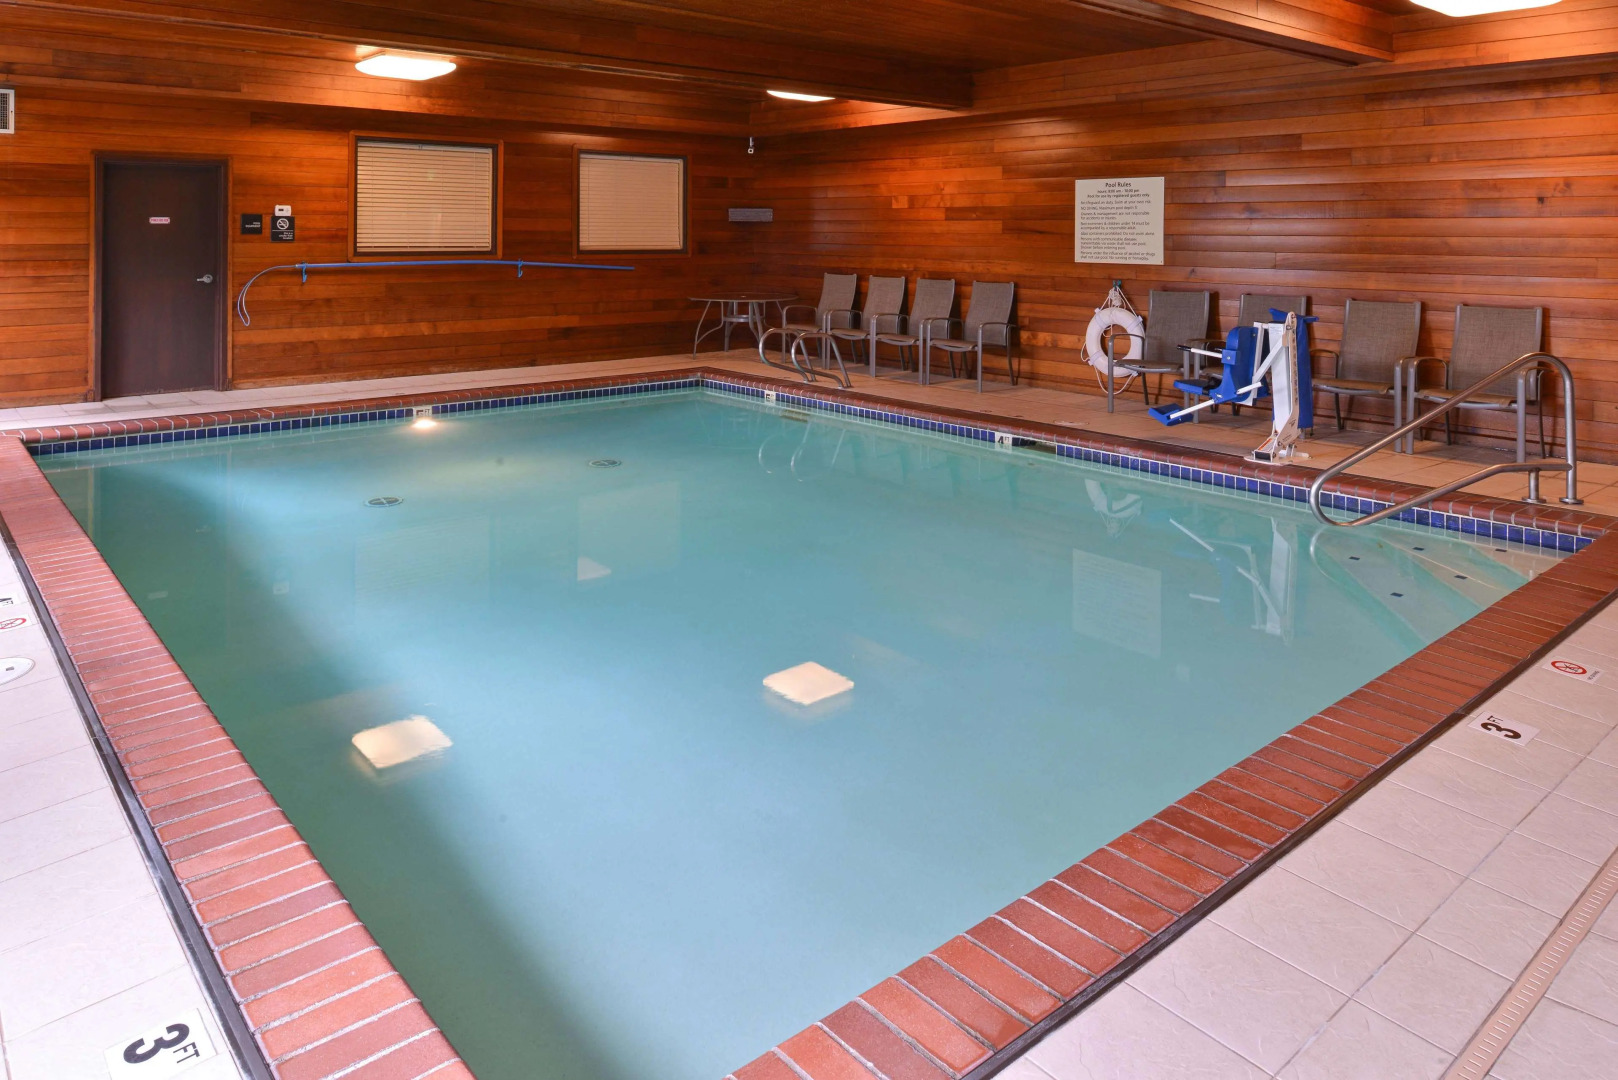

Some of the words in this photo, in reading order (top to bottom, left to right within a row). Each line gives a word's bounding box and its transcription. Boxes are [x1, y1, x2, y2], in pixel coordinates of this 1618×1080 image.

[1486, 715, 1503, 724] FT
[1480, 722, 1522, 740] 3
[123, 1023, 190, 1064] 3
[173, 1041, 200, 1064] FT
